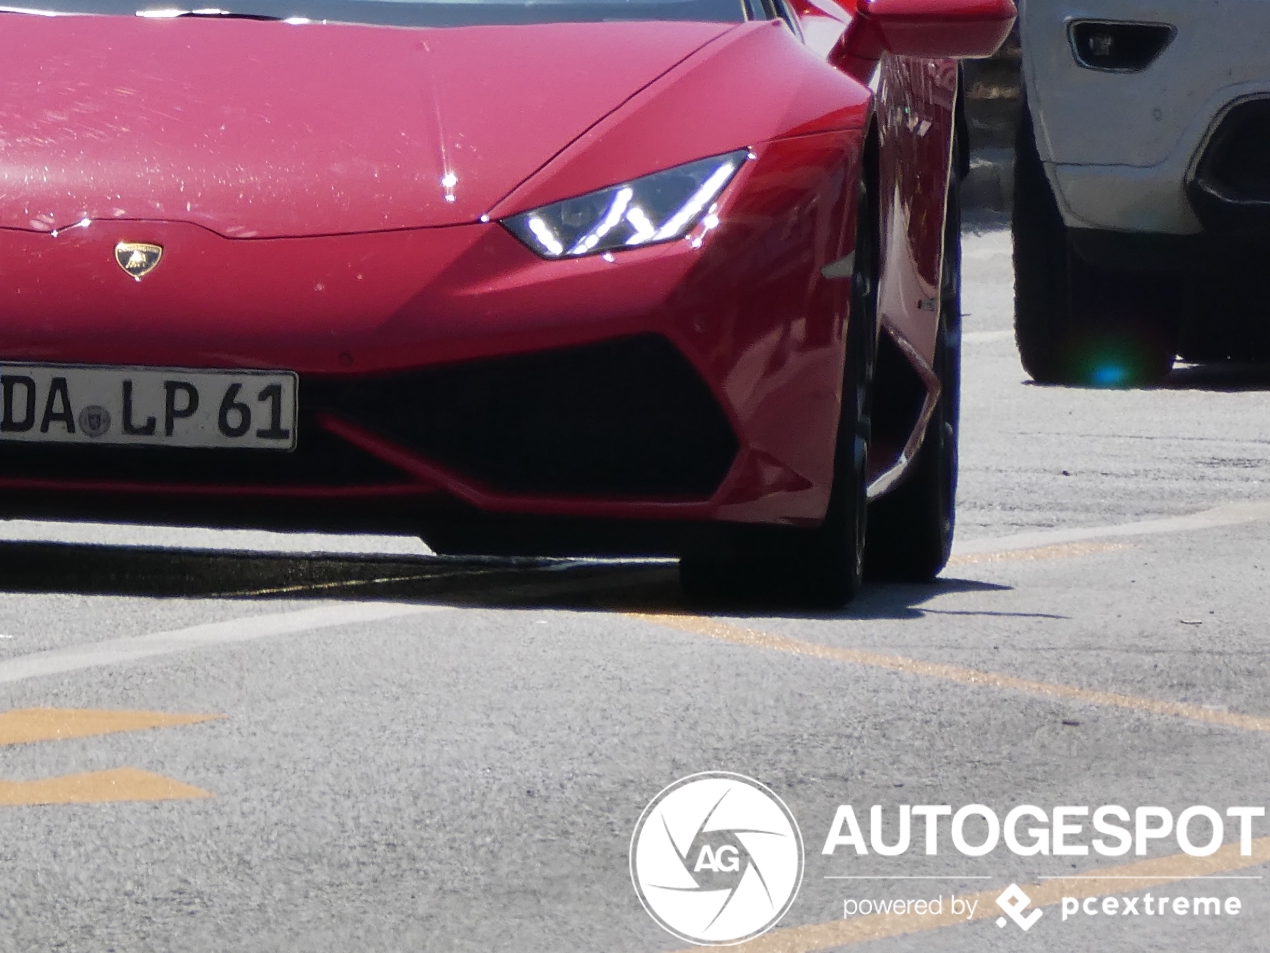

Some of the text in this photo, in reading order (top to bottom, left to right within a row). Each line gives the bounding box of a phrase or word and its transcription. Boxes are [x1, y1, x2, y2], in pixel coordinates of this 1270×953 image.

[0, 374, 290, 440] DA LP 61
